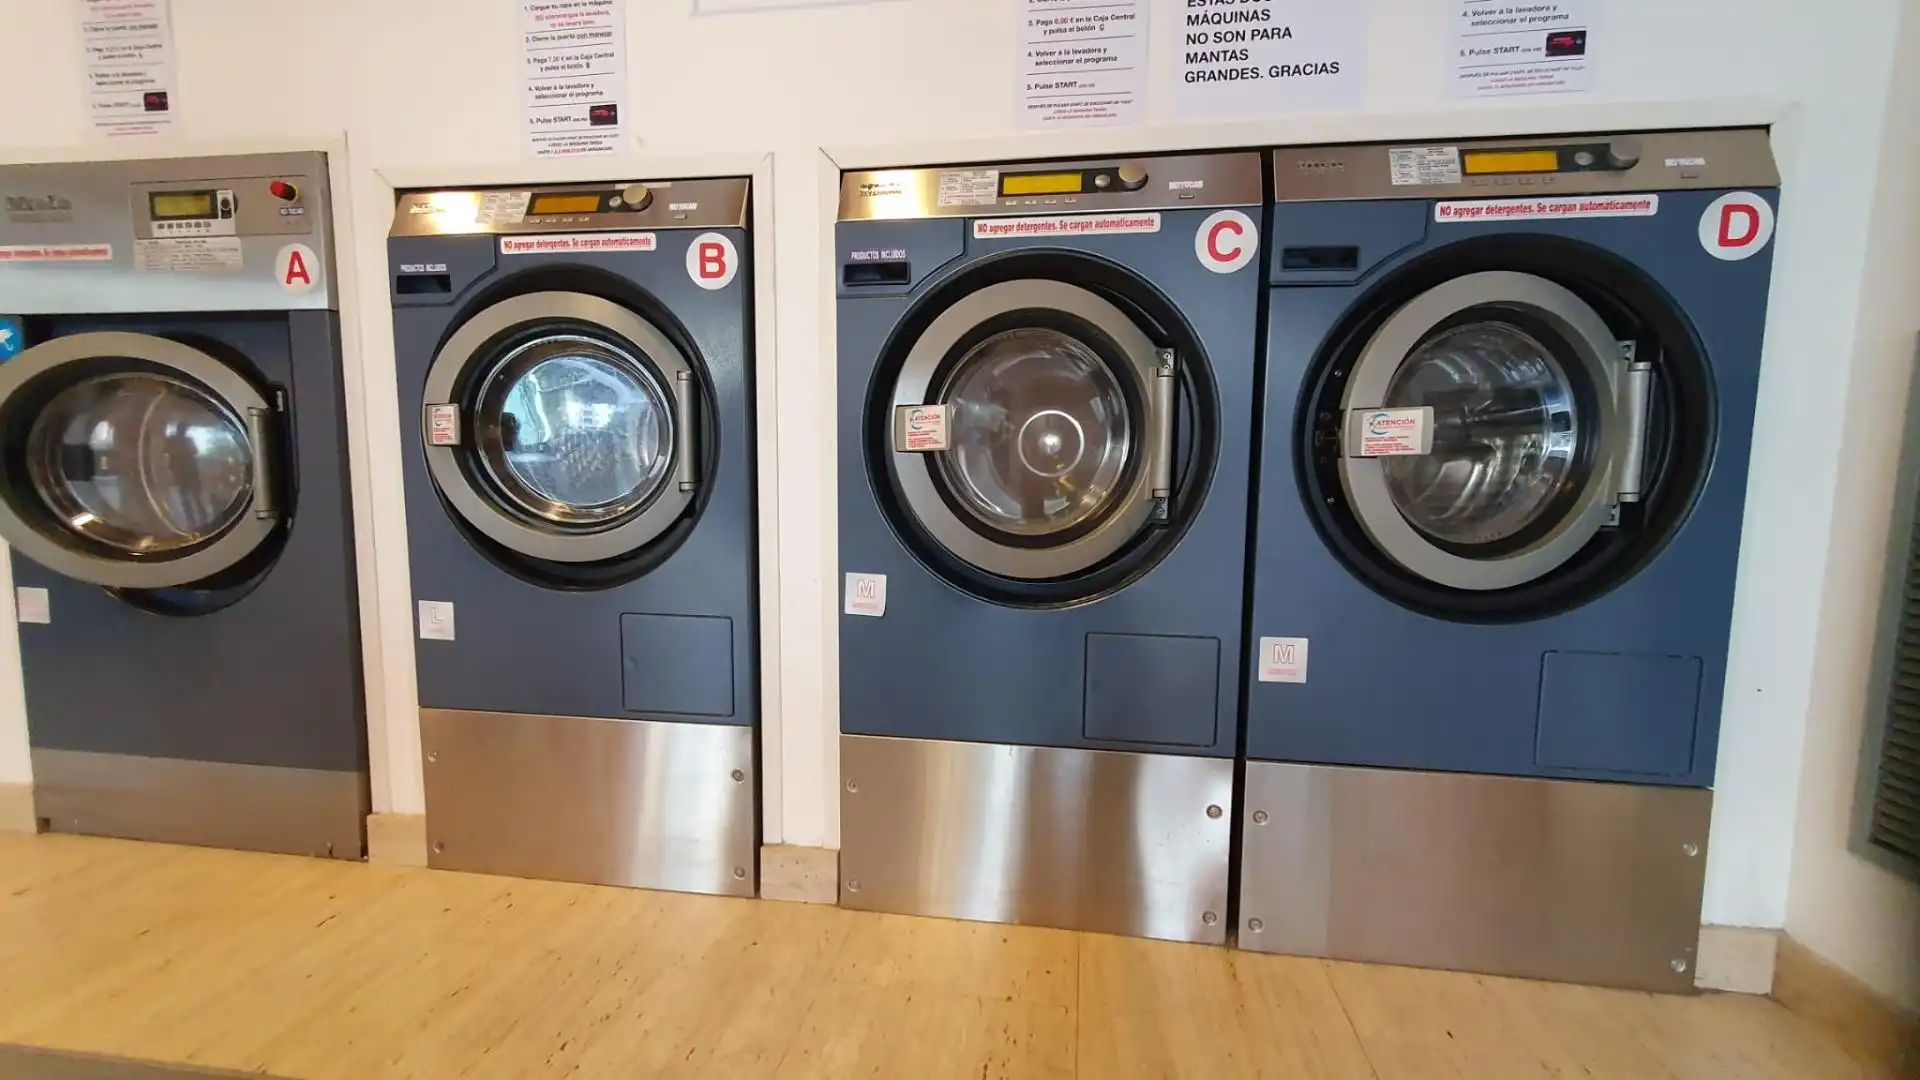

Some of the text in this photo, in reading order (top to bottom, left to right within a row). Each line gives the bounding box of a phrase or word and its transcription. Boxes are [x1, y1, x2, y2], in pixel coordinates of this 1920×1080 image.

[1186, 9, 1271, 26] MÁQUINAS
[1471, 9, 1496, 17] Volver
[1515, 5, 1551, 14] lavadora
[1552, 4, 1558, 12] y
[1471, 17, 1518, 27] seleccionar
[1528, 14, 1570, 24] programa
[1186, 26, 1293, 46] NO SON PARA
[1185, 48, 1249, 65] MANTAS
[1468, 47, 1492, 57] Pulse
[1493, 45, 1520, 54] START
[1184, 61, 1340, 84] GRANDES. GRACIAS
[1034, 82, 1053, 90] Pulse
[1054, 81, 1078, 89] START
[1440, 206, 1451, 216] NO
[1453, 207, 1484, 218] agregar
[1485, 203, 1534, 216] detergentes.
[1537, 202, 1546, 212] Se
[1548, 203, 1577, 215] cargan
[978, 223, 987, 233] NO
[989, 224, 1015, 234] agregar
[1015, 220, 1057, 233] detergentes.
[1059, 220, 1068, 230] Se
[1069, 220, 1093, 231] cargan
[1718, 204, 1760, 247] D
[1207, 219, 1244, 263] C
[286, 251, 311, 285] A
[699, 242, 726, 279] B
[1376, 416, 1416, 426] ATENCIÓN
[857, 579, 876, 599] M
[1273, 643, 1296, 664] M
